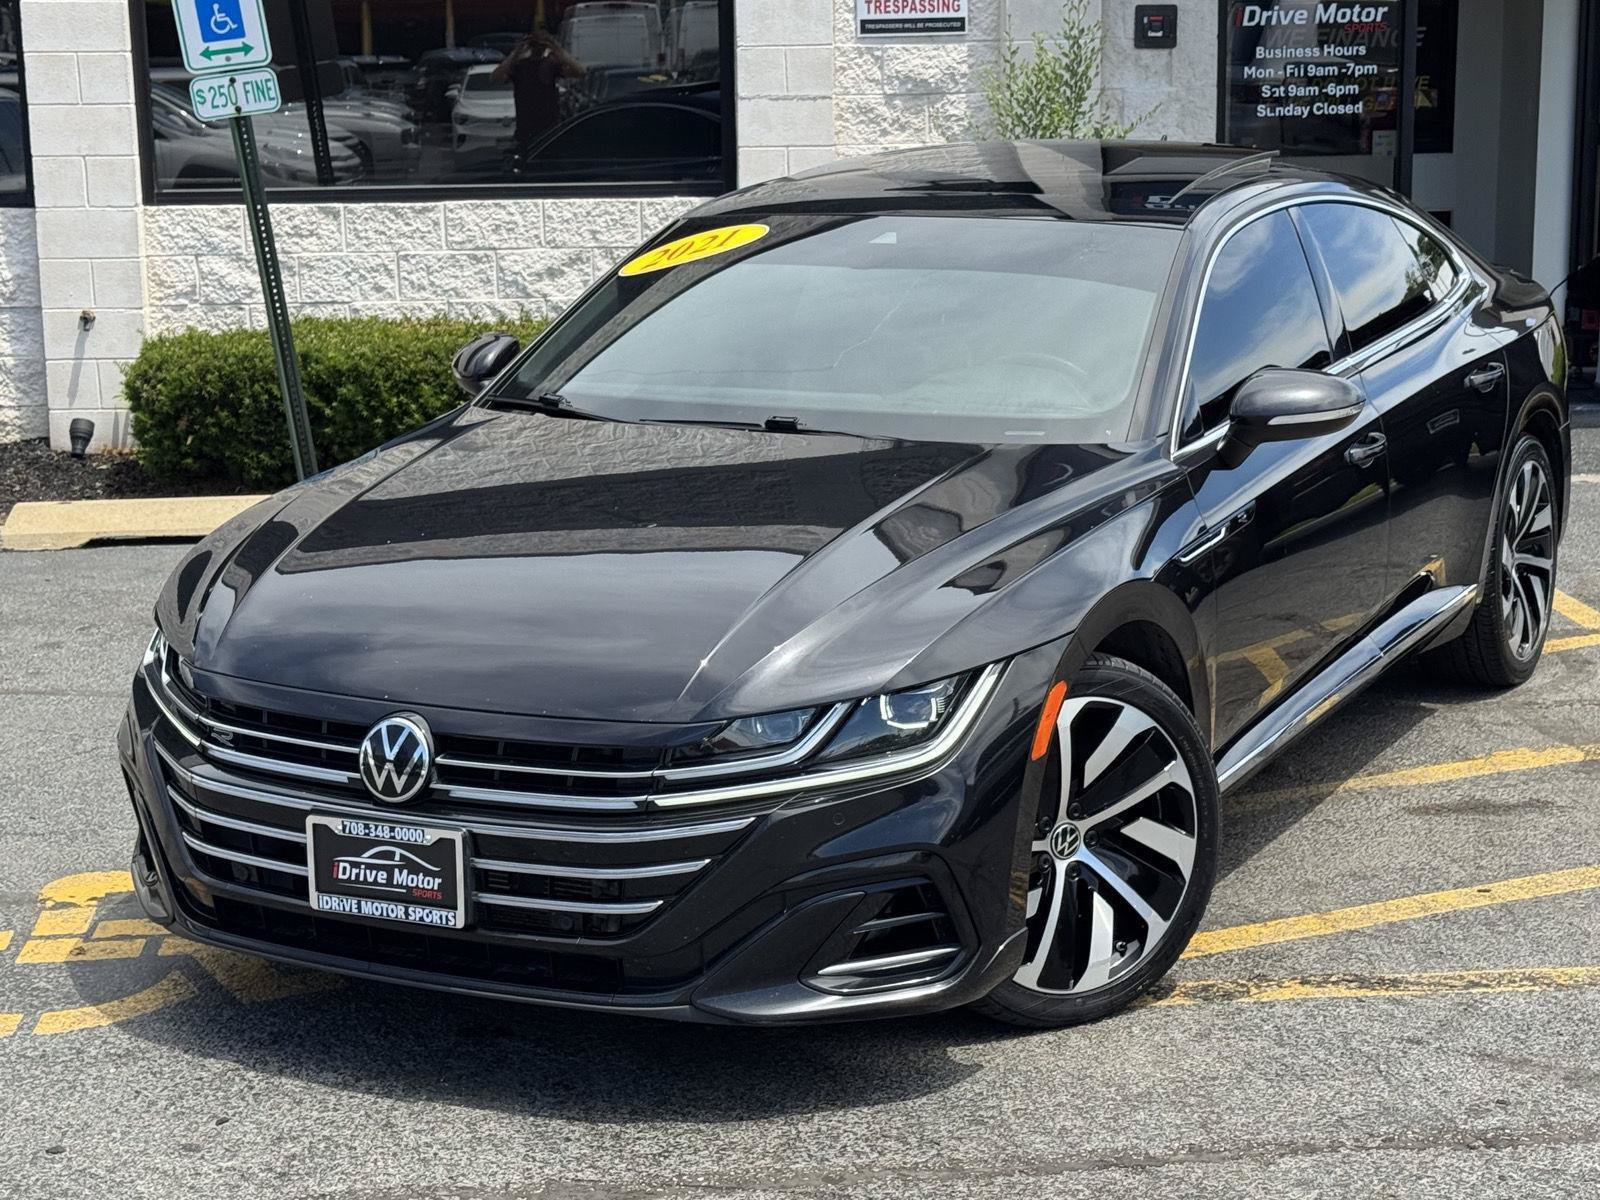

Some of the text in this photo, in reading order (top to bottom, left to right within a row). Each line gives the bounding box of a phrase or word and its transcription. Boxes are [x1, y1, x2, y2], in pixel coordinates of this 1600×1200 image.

[864, 0, 961, 14] TRESPASSING
[1234, 3, 1389, 27] iDrive Motor
[1344, 22, 1388, 33] SPORTS
[1255, 44, 1367, 59] Business Hours
[1243, 66, 1274, 79] Mon
[1285, 64, 1305, 78] Fri
[1307, 64, 1339, 77] 9am
[196, 78, 276, 110] $250 FINE
[1261, 84, 1285, 98] Sat
[1288, 84, 1319, 97] 9am
[1256, 104, 1311, 119] Sunday
[1313, 101, 1363, 115] Closed
[640, 229, 741, 270] 2021
[343, 821, 424, 843] 708-348-0000
[332, 862, 442, 891] iDrive Motor
[411, 888, 443, 900] SPORTS
[361, 901, 406, 919] MOTOR
[408, 908, 456, 926] SPORTS
